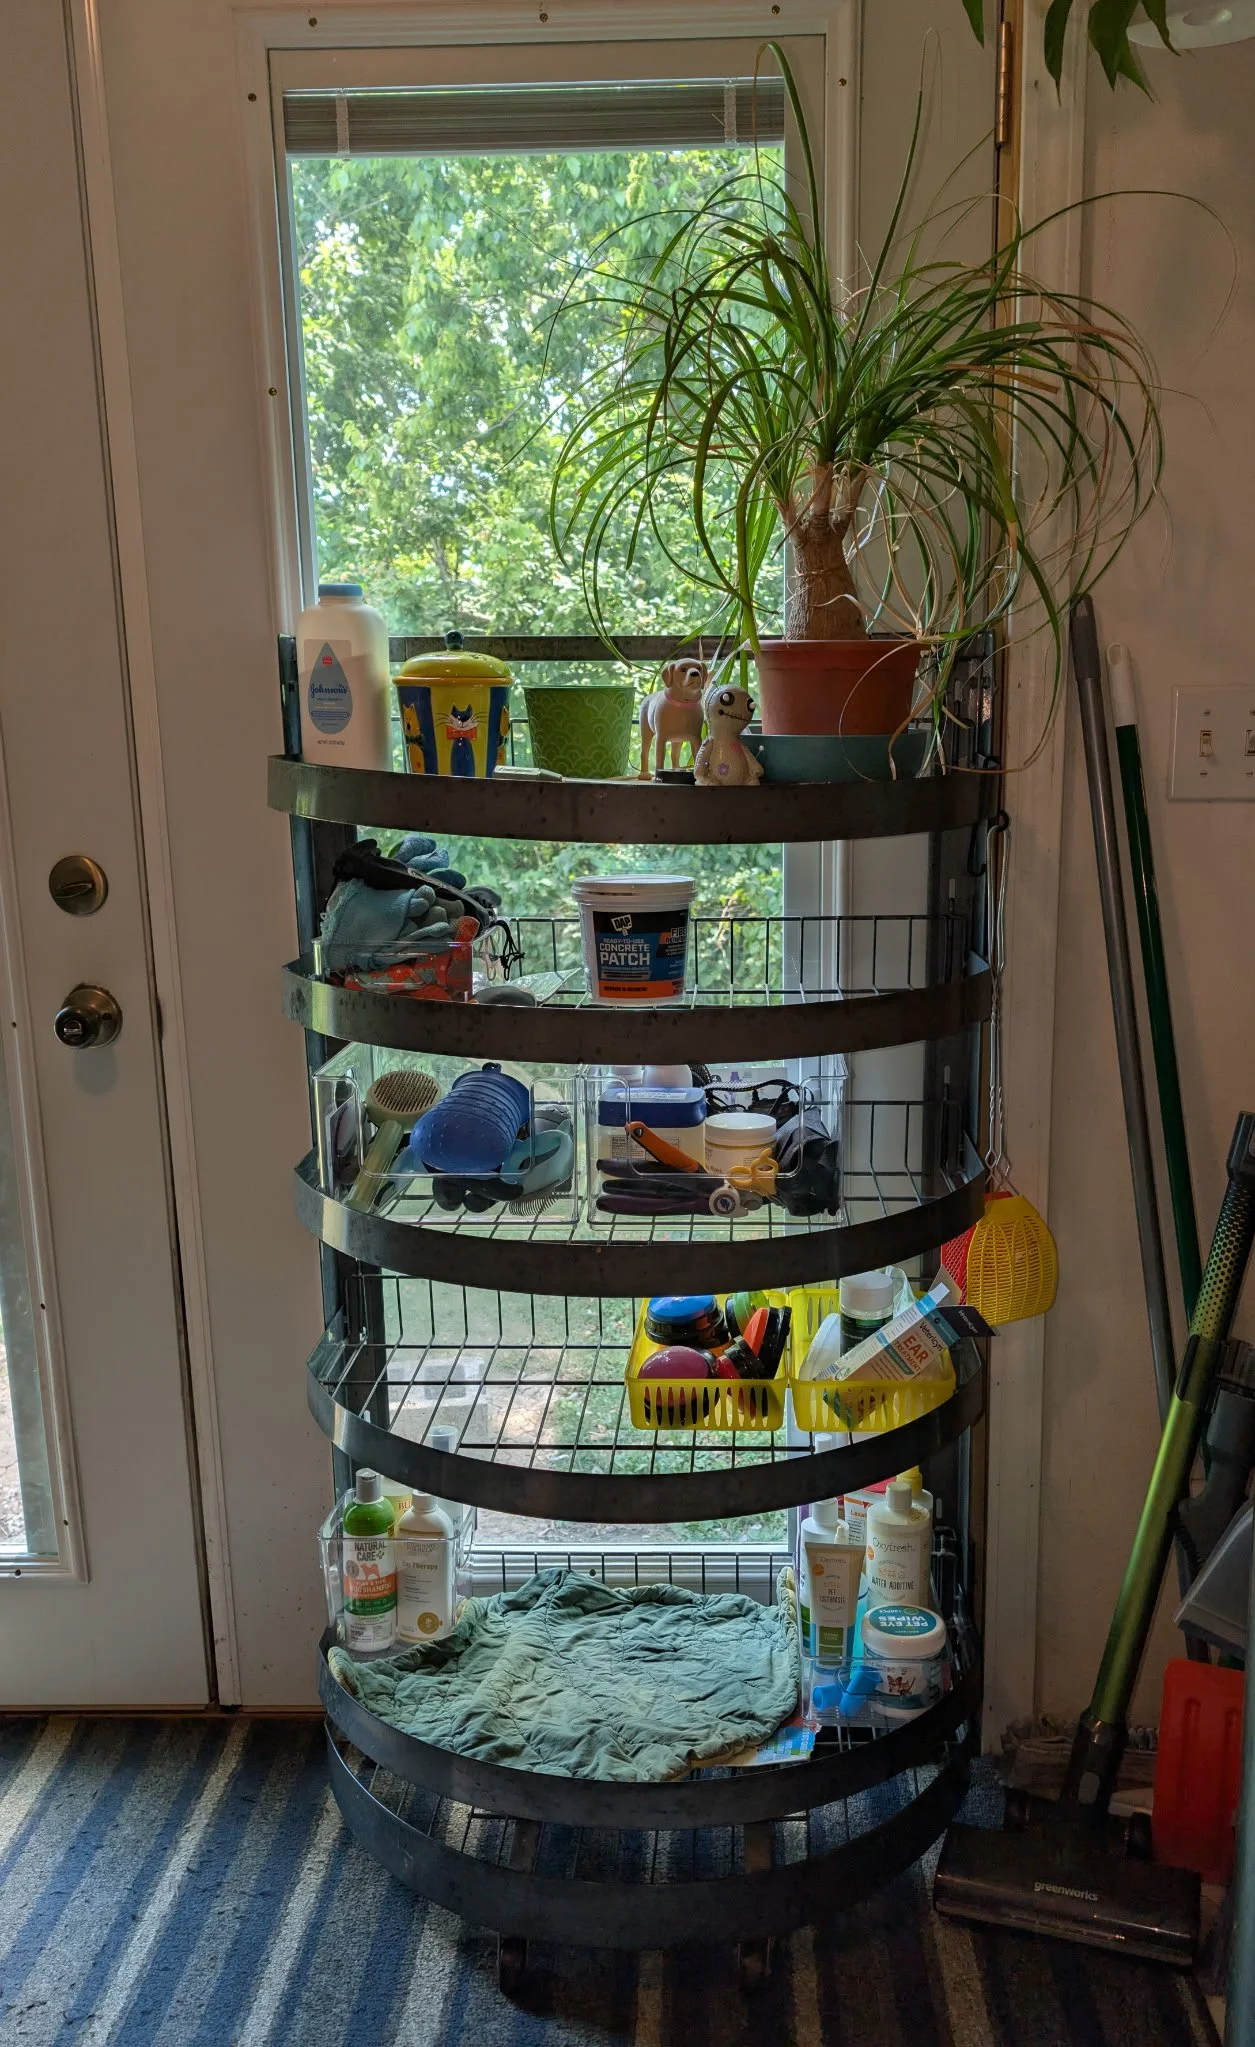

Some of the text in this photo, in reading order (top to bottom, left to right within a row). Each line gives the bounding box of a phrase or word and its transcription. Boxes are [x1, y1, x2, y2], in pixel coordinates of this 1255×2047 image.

[599, 943, 651, 952] CONCRETE
[600, 952, 651, 966] PATCH
[919, 1321, 944, 1352] Vetericyn
[903, 1335, 929, 1365] EAR
[892, 1340, 922, 1373] TREATMENT
[354, 1541, 387, 1552] NATURAL
[356, 1552, 376, 1561] CARE
[412, 1562, 438, 1572] Therapy
[888, 1580, 915, 1590] ADDITIVE
[1033, 1881, 1098, 1901] greenworks
